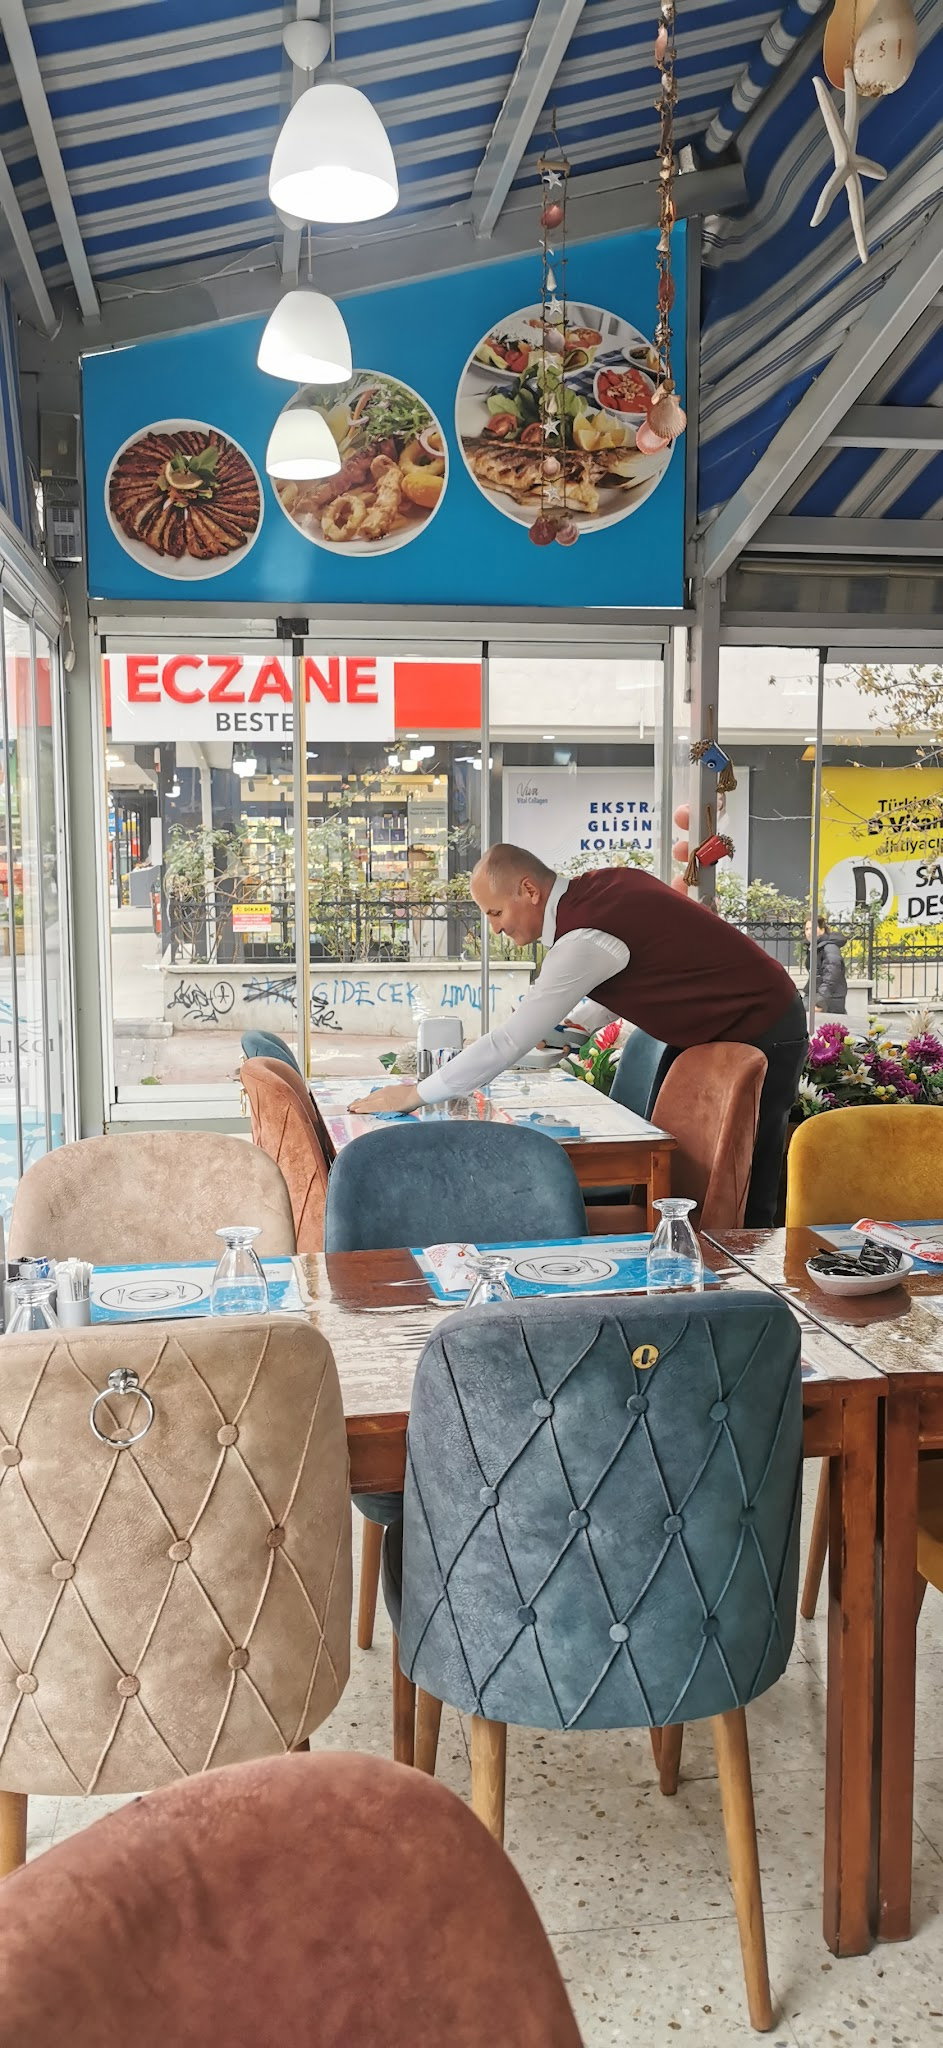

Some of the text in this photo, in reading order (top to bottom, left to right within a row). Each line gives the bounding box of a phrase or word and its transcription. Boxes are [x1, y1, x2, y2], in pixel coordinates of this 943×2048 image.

[126, 655, 378, 703] ECZANE
[216, 712, 293, 732] BESTE
[590, 802, 655, 813] EKSTR
[588, 817, 651, 832] GLİSİN
